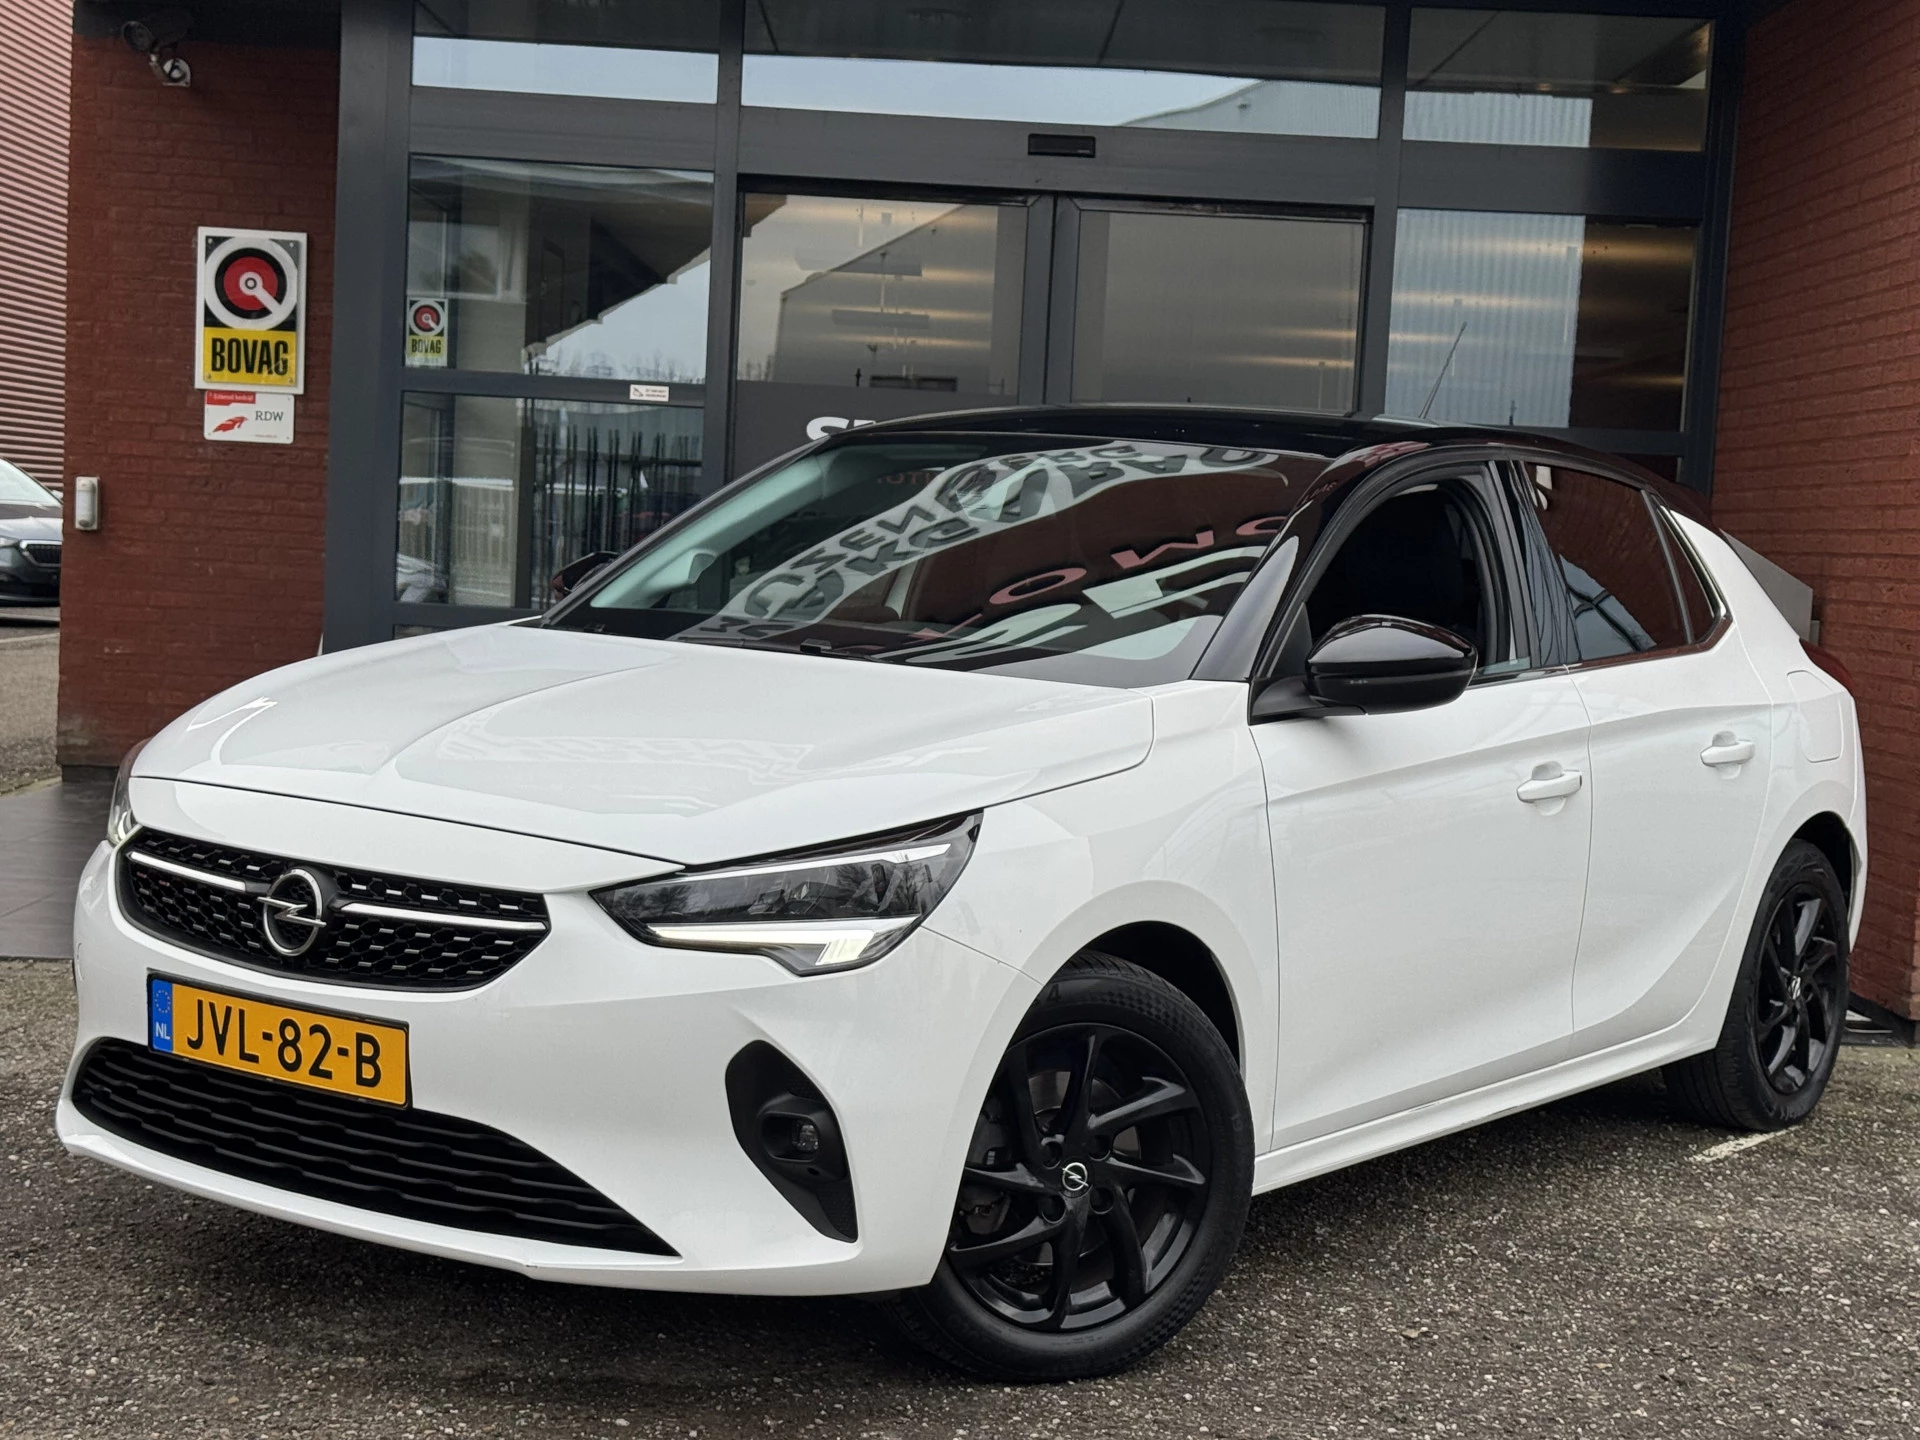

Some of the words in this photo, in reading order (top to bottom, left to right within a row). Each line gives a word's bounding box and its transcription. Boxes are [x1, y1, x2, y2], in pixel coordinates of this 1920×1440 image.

[411, 339, 442, 354] BOVAG
[211, 337, 288, 376] BOVAG
[255, 410, 284, 422] RDW
[155, 1022, 171, 1040] NL
[187, 999, 382, 1088] JVL-82-B
